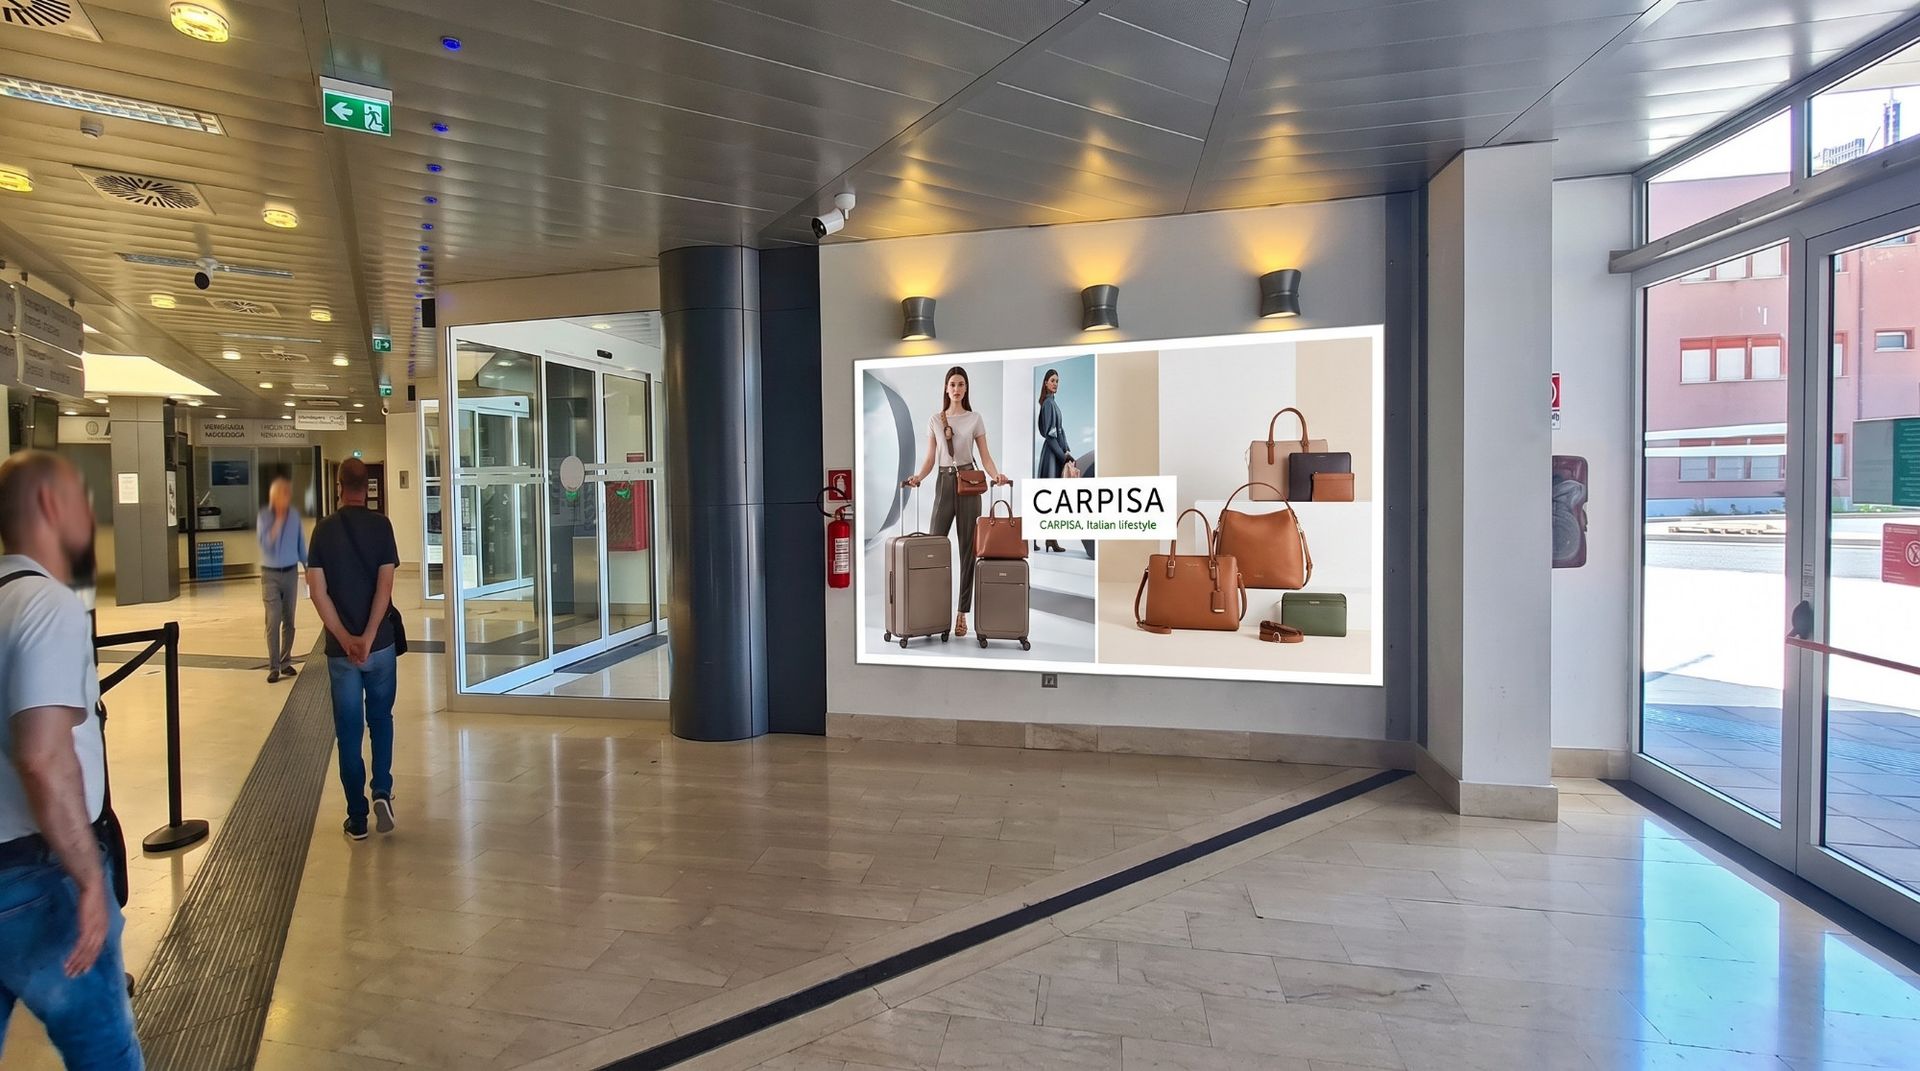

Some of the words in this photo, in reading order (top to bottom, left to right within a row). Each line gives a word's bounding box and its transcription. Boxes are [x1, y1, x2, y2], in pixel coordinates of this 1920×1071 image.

[1033, 487, 1165, 515] CARPISA
[1039, 520, 1084, 531] CARPISA,
[1086, 520, 1116, 530] Italian
[1119, 519, 1157, 532] lifestyle
